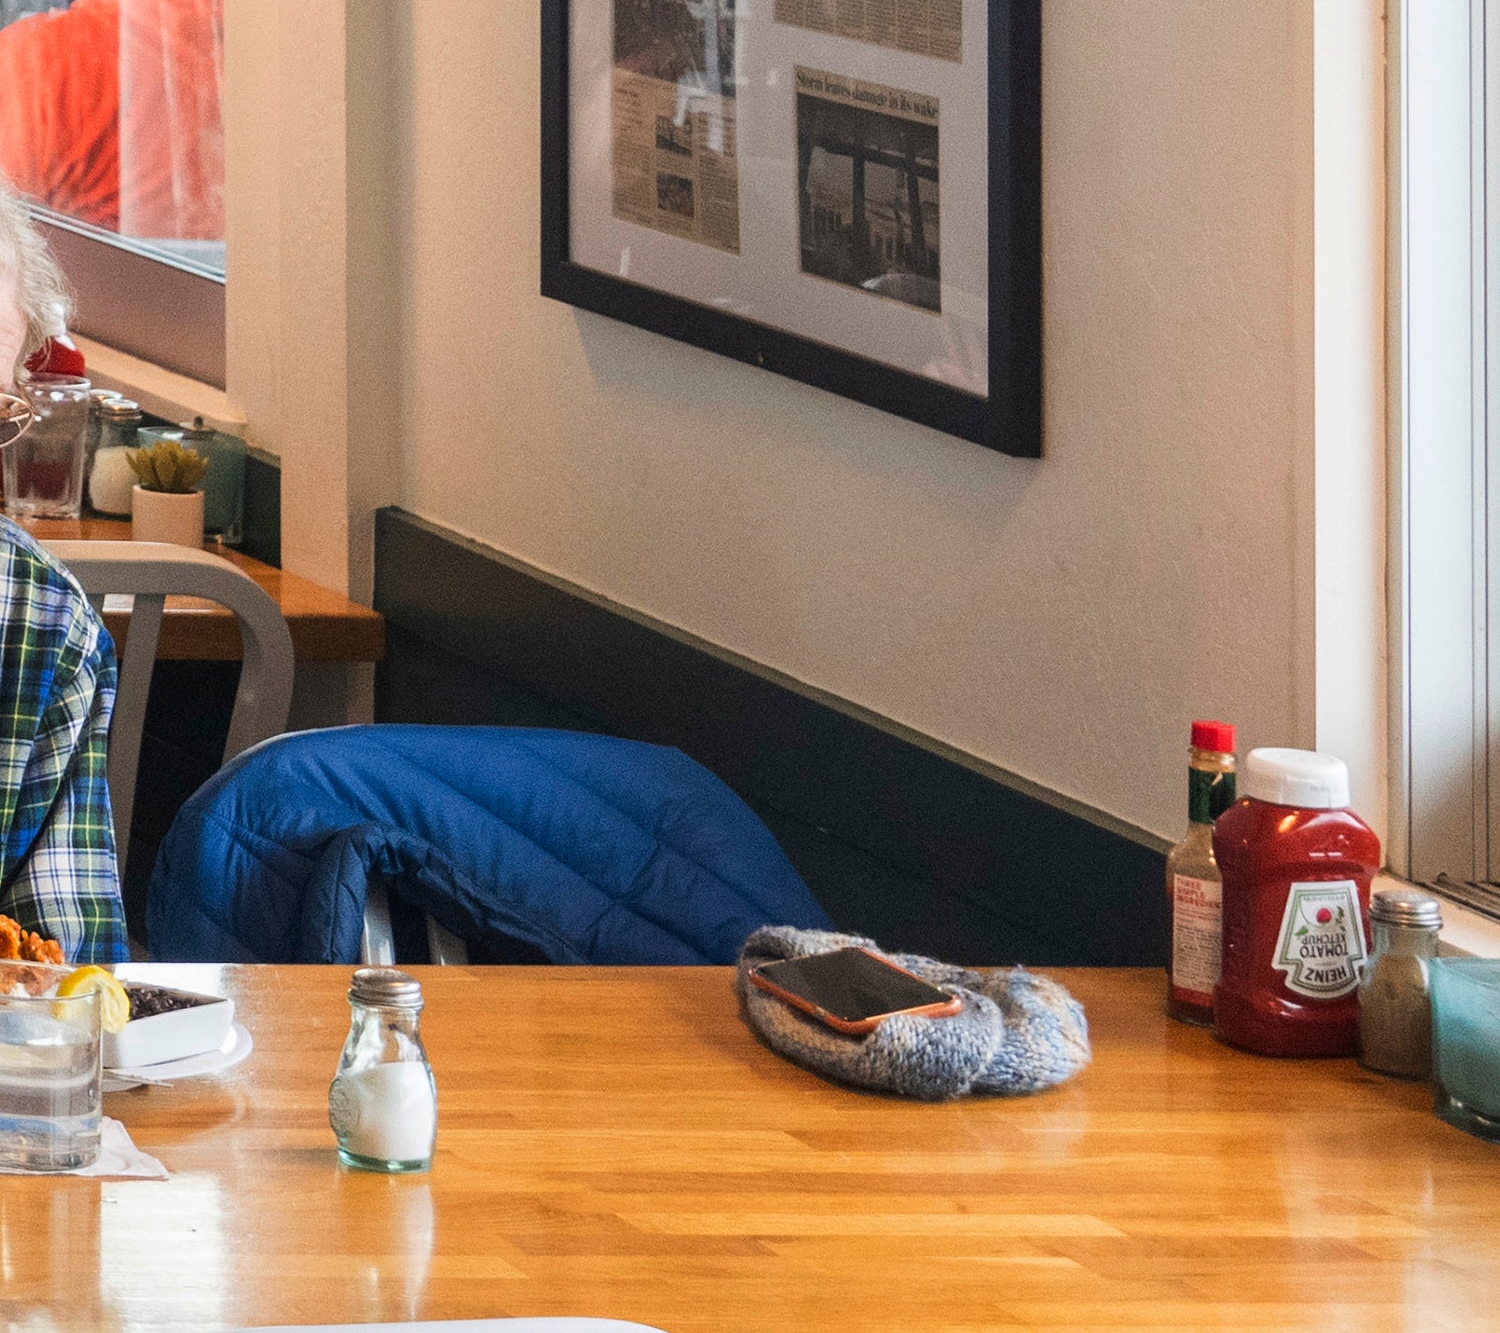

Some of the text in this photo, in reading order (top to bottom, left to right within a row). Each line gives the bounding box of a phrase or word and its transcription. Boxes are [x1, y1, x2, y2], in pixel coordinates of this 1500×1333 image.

[796, 70, 939, 118] Storm leaves damage in its wake
[1301, 933, 1347, 945] KETCHUP
[1300, 944, 1349, 959] TOMATO
[1304, 965, 1348, 984] HEINZ
